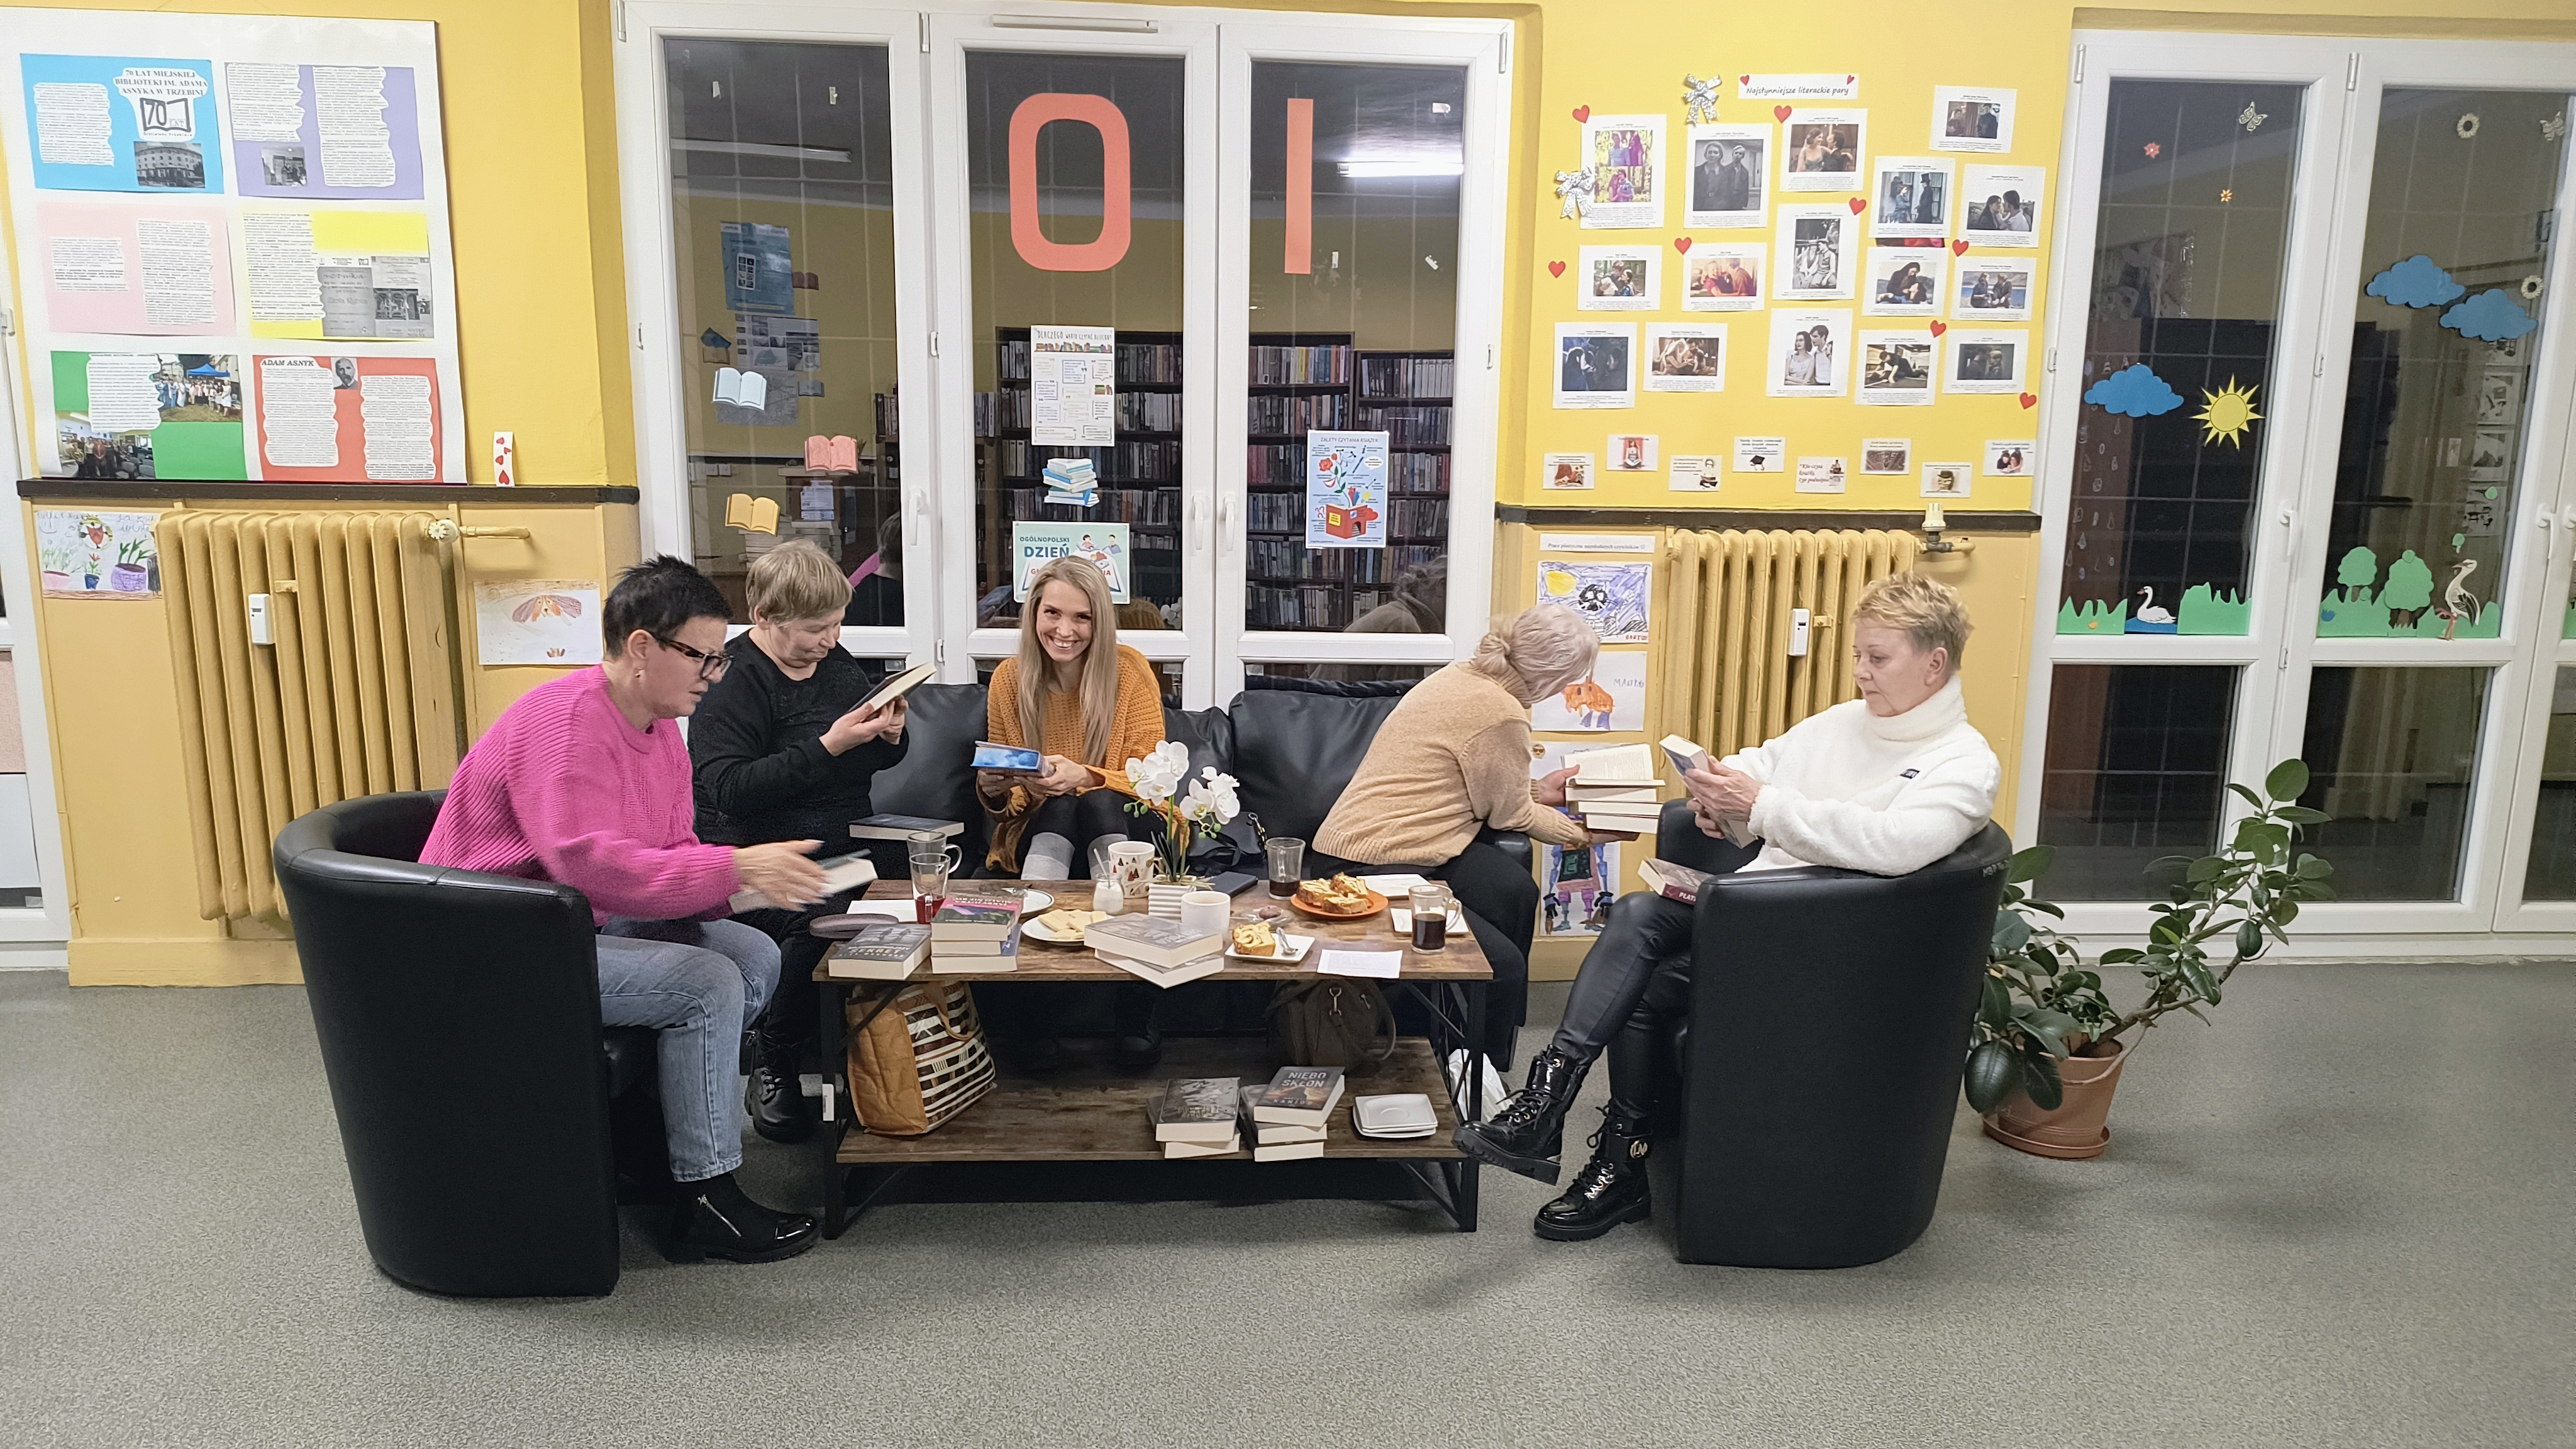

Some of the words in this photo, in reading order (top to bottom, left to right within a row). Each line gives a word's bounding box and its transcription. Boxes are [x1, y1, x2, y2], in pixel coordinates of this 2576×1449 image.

[115, 78, 162, 86] BIBLIOTEKI
[1746, 86, 1796, 96] Najsłynniejsze
[1831, 87, 1849, 96] pary
[145, 99, 167, 126] 70
[1038, 330, 1063, 340] DLACZEGO
[1024, 543, 1070, 558] DZIEŃ
